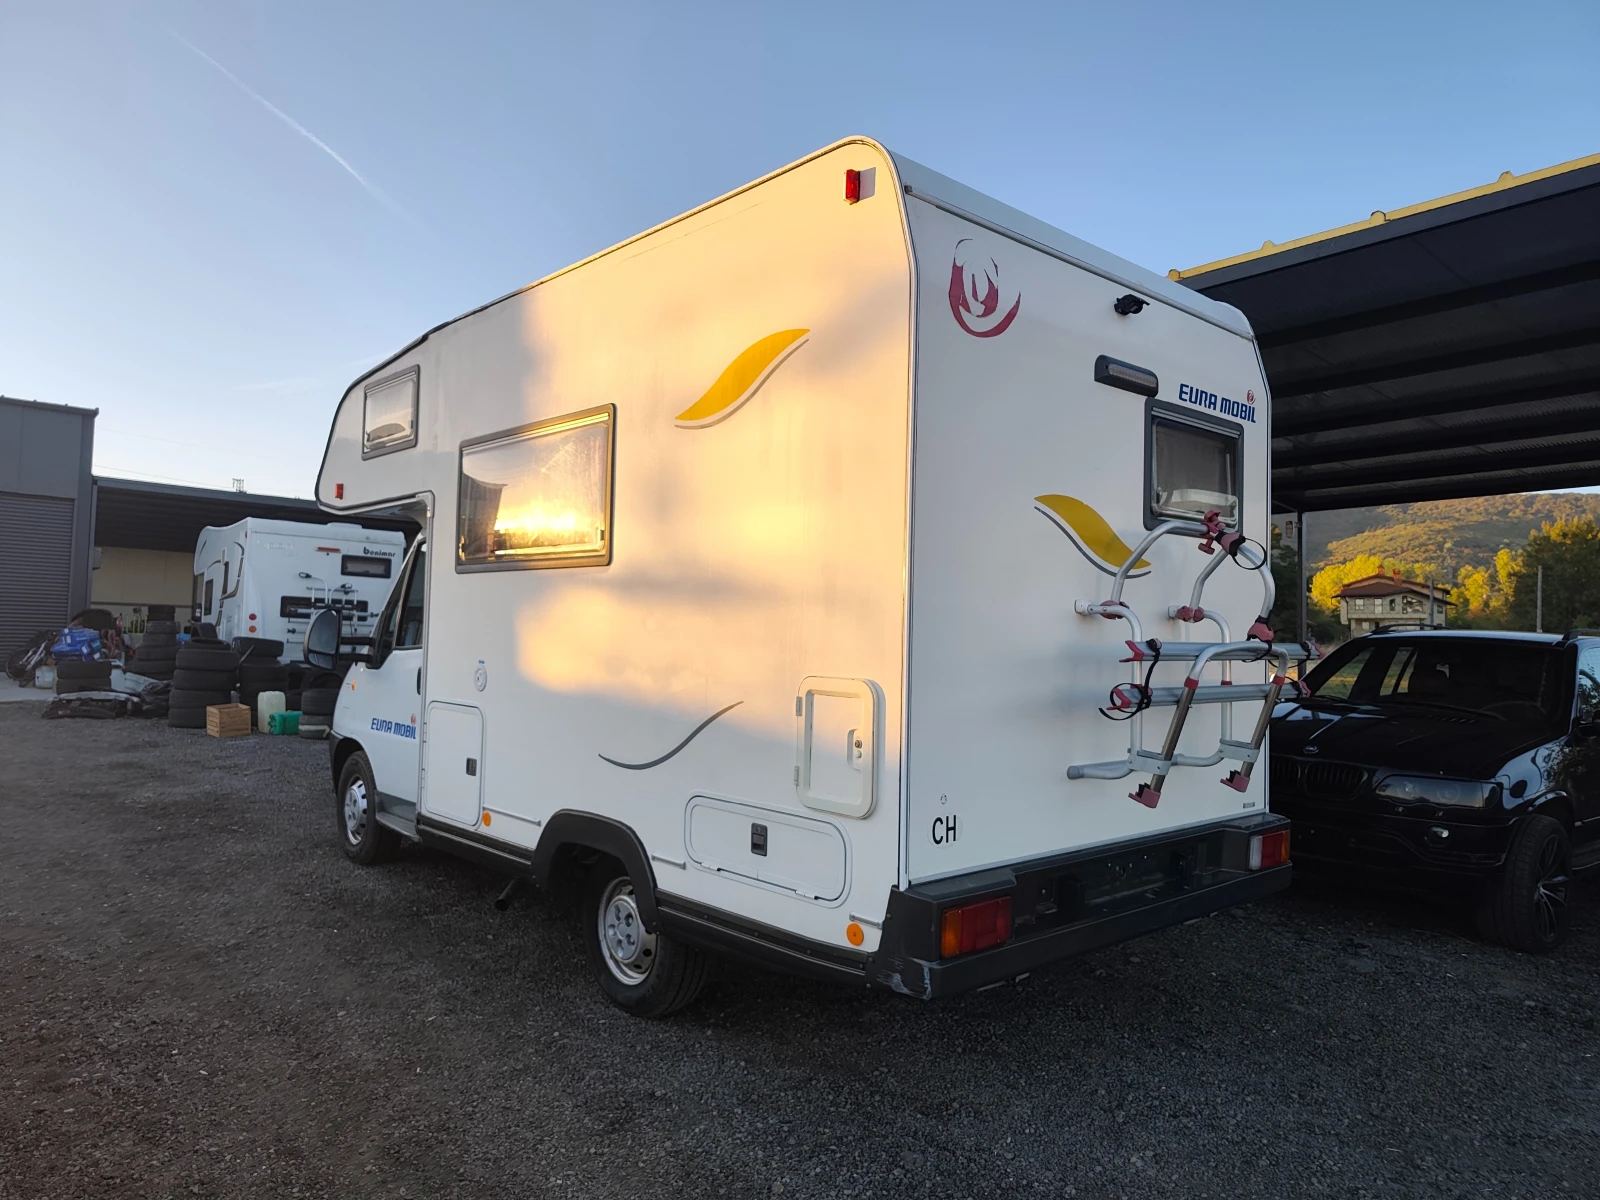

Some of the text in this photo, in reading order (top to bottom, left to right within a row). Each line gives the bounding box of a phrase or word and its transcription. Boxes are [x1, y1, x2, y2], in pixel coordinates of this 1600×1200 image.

[1179, 383, 1256, 423] EURA MOBIL
[363, 546, 396, 557] benimar
[370, 717, 417, 739] EURA MOBIL
[932, 814, 957, 845] CH
